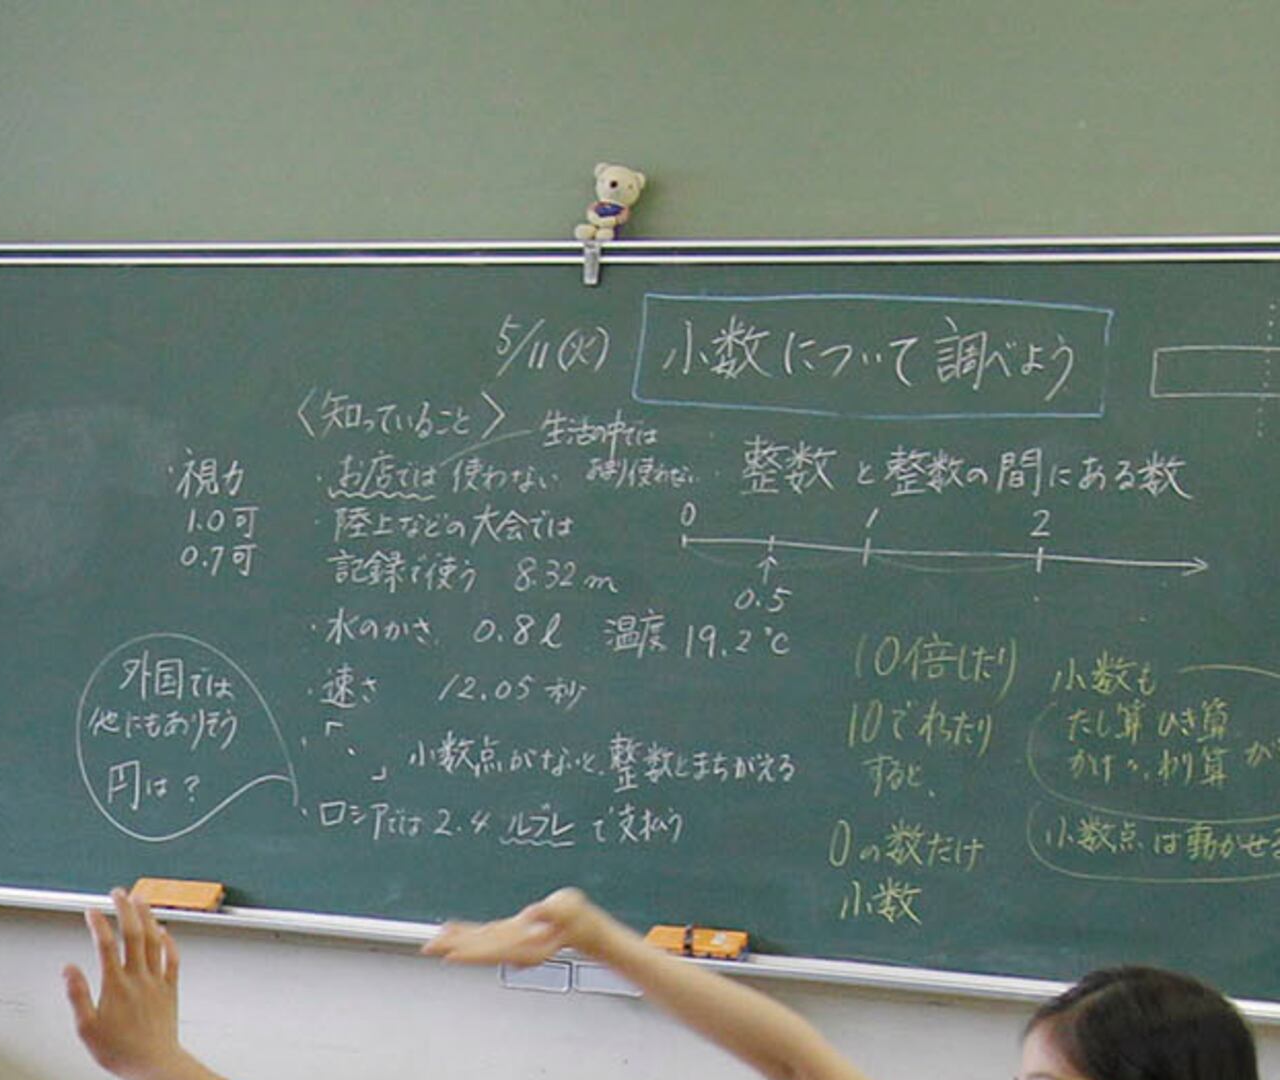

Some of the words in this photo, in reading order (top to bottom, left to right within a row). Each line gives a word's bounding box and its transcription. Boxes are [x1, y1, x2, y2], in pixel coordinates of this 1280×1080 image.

[662, 313, 1075, 401] 小数について調べよう
[1030, 510, 1051, 537] 2
[734, 587, 792, 612] 0.5
[839, 877, 922, 926] 小数
